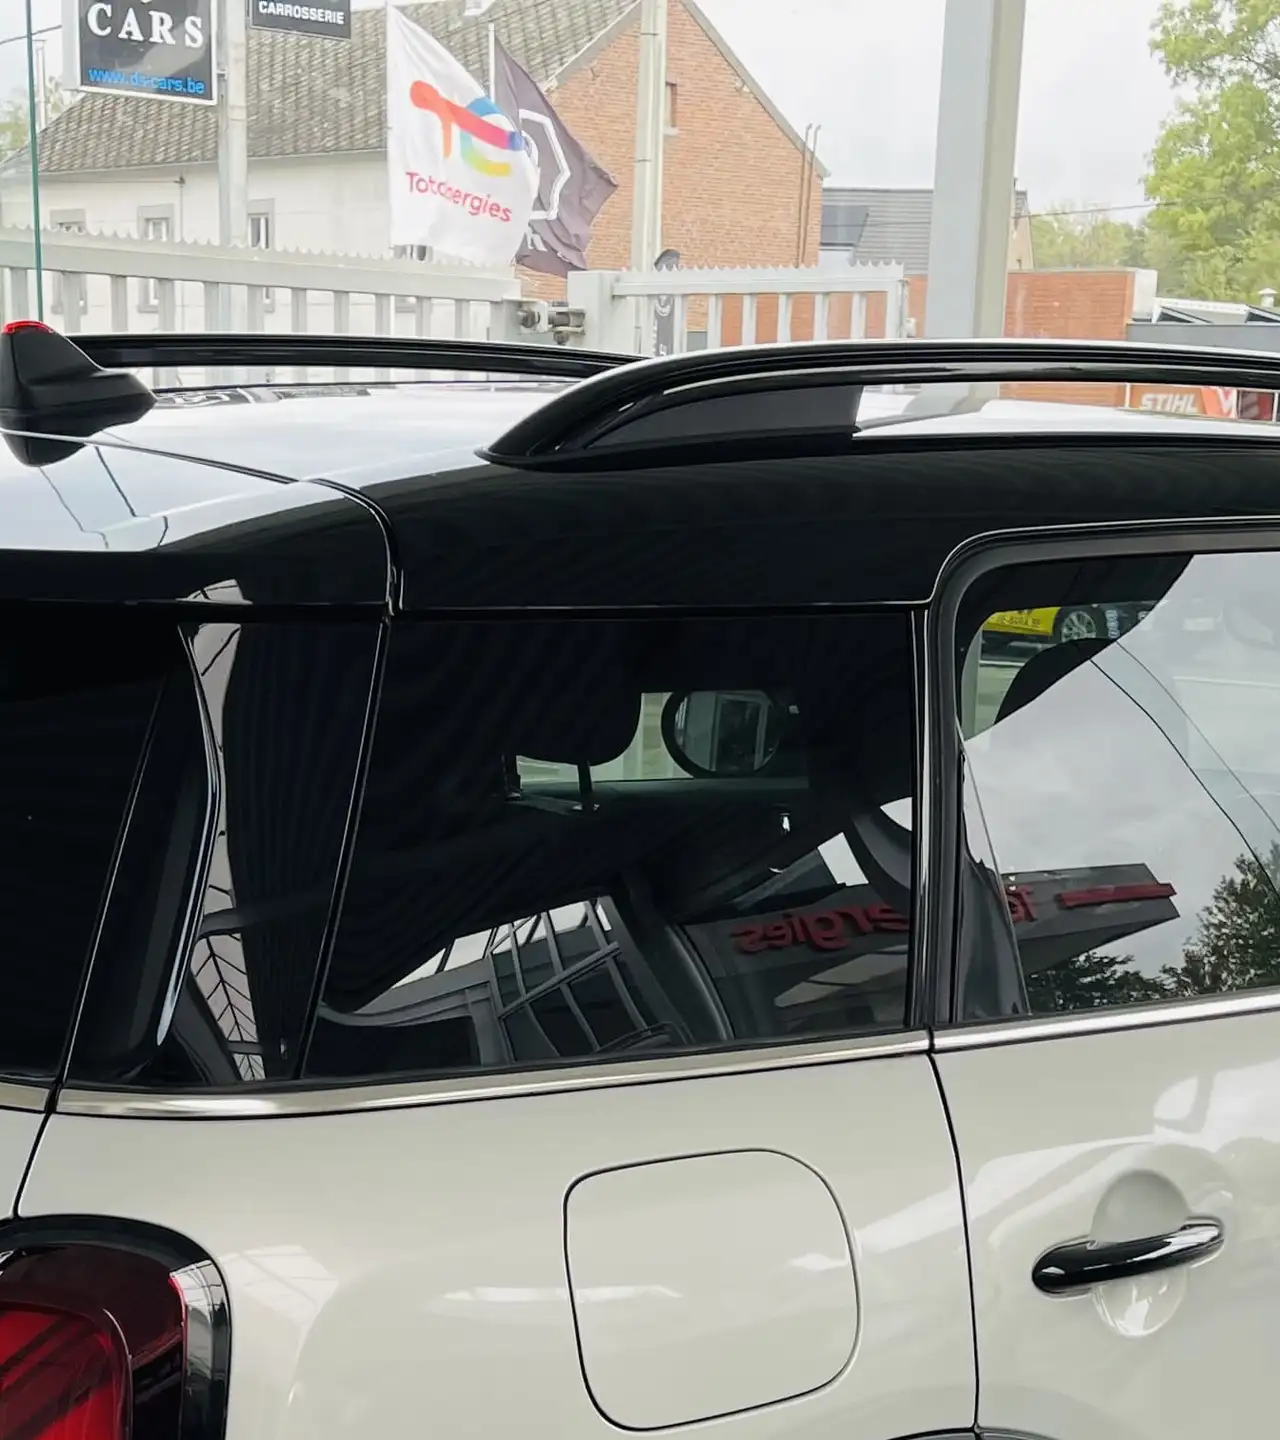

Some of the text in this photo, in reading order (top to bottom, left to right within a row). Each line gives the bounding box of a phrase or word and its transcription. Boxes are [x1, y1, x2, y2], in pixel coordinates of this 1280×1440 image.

[87, 2, 204, 48] CARS
[258, 0, 345, 25] CARROSSERIE
[1141, 391, 1198, 414] STIHL
